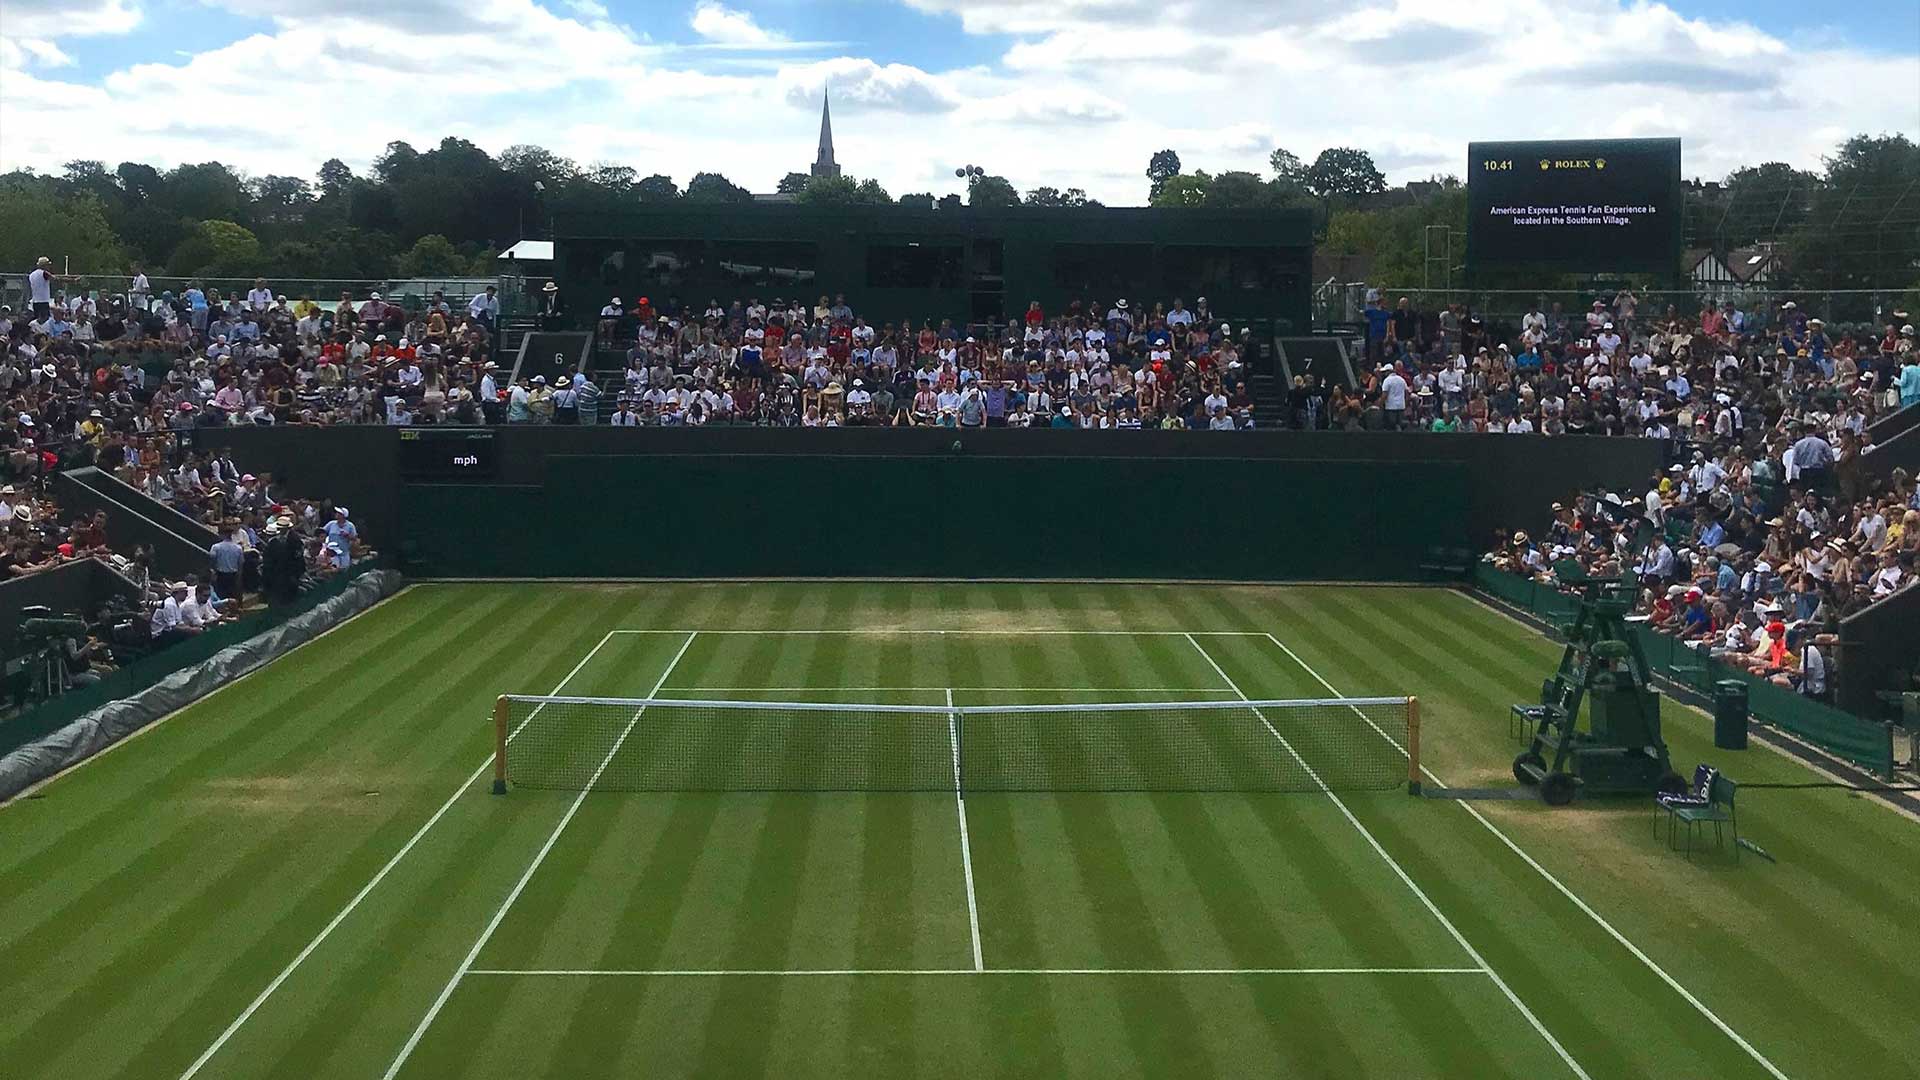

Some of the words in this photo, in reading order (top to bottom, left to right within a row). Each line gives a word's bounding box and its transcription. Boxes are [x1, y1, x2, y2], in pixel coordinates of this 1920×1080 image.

[1484, 160, 1513, 171] 10.41
[1555, 160, 1591, 169] ROLEX
[1490, 206, 1526, 215] American
[1527, 206, 1558, 216] Express
[1560, 205, 1586, 214] Tennis
[1587, 205, 1602, 214] Fan
[1604, 205, 1647, 215] Experience
[1648, 204, 1656, 213] is
[1513, 216, 1542, 225] located
[1543, 216, 1551, 225] in
[1552, 216, 1564, 225] the
[1566, 216, 1601, 225] Southern
[1602, 215, 1631, 226] Village.
[555, 353, 563, 365] 6
[1304, 358, 1313, 370] 7
[453, 455, 478, 466] mph
